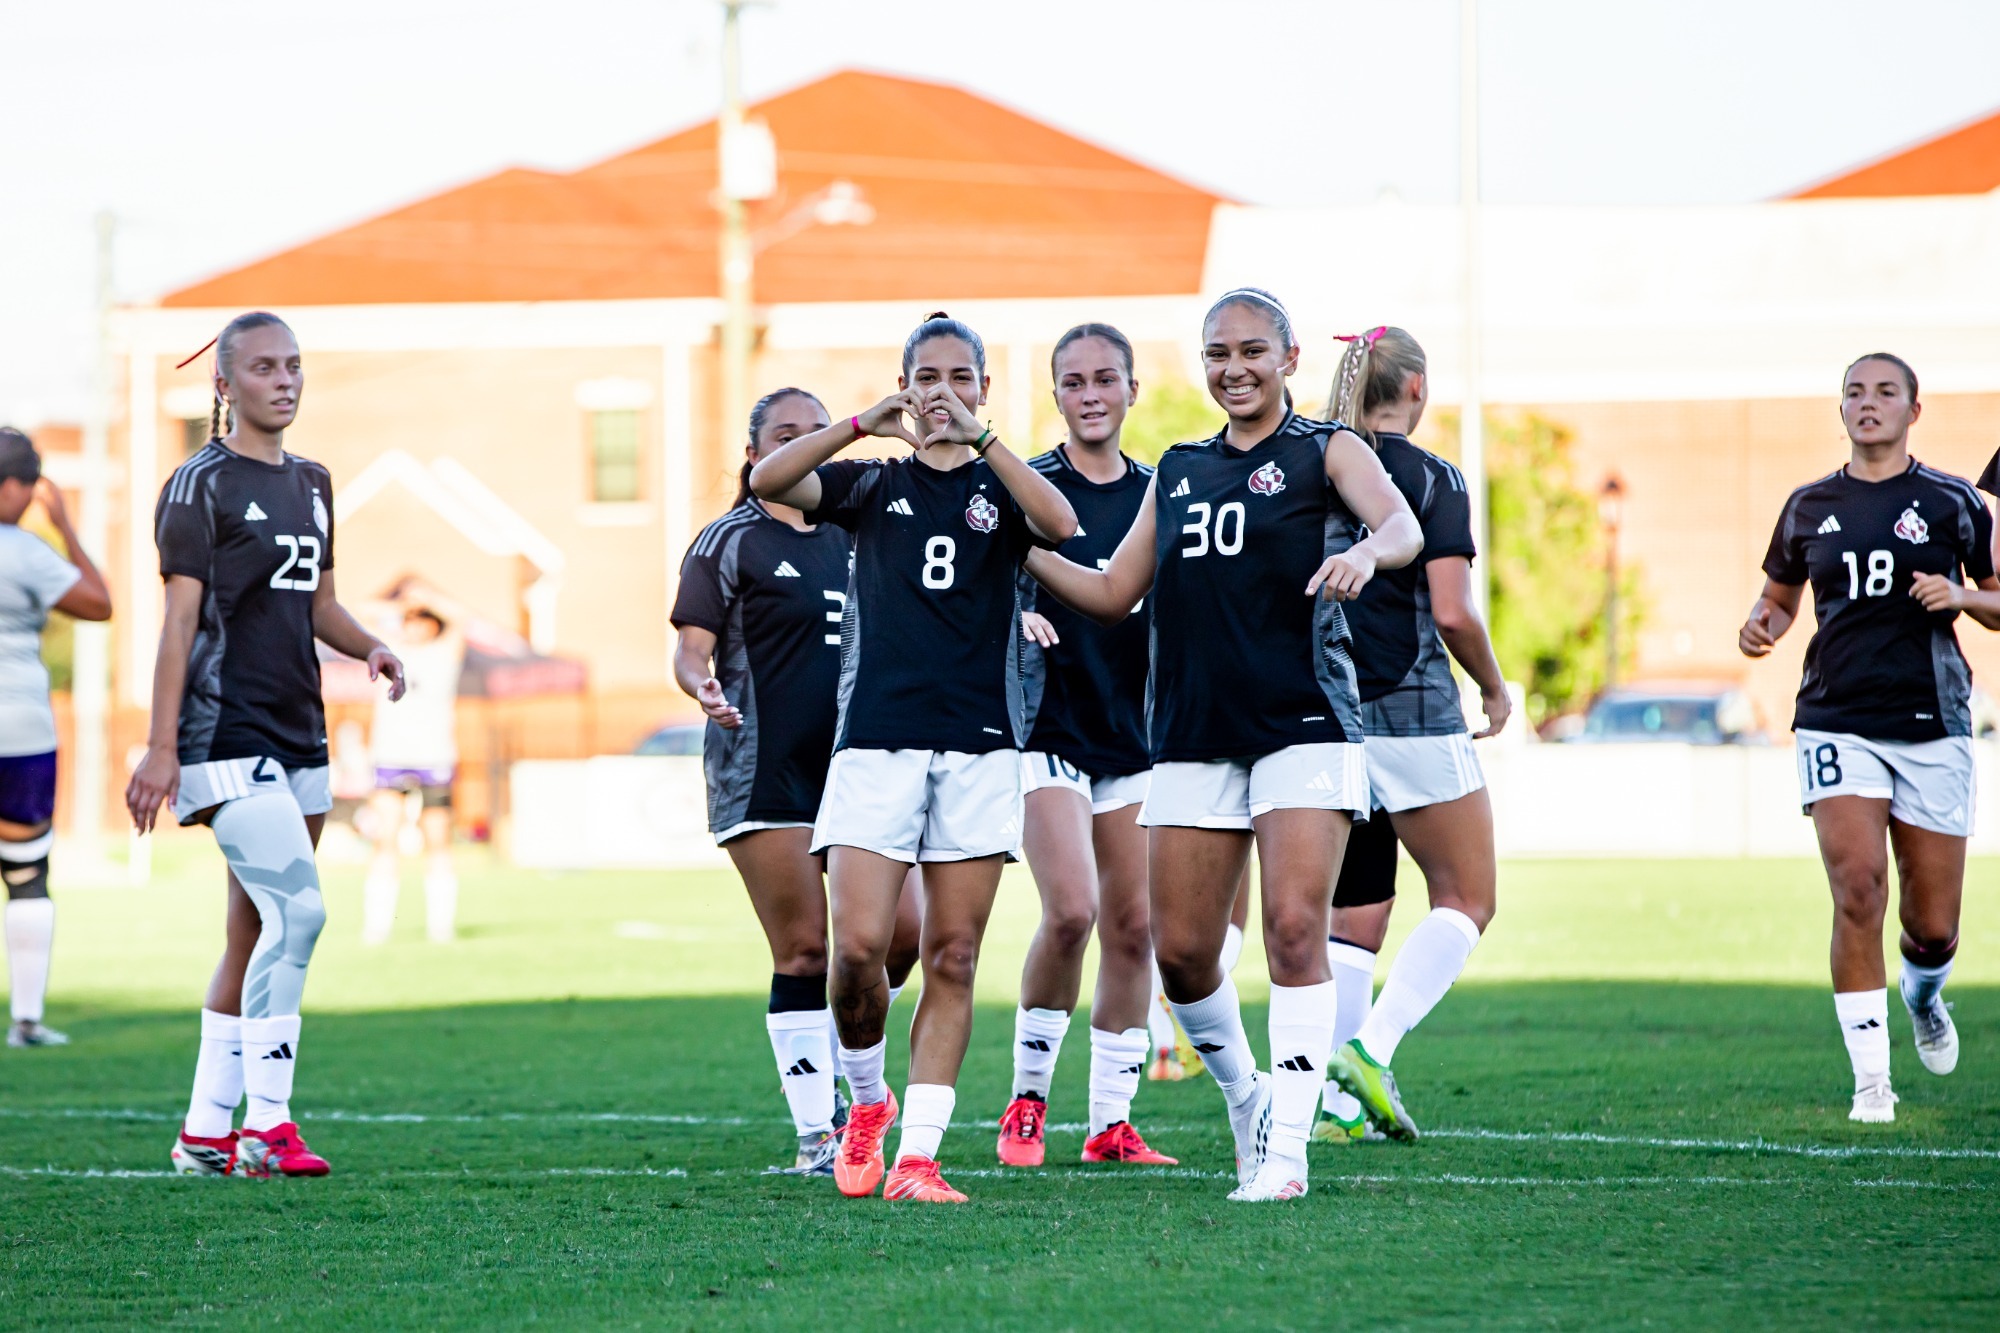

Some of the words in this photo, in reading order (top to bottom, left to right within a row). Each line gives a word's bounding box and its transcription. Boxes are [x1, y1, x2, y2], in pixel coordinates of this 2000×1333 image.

[1182, 502, 1246, 558] 30
[269, 534, 321, 591] 23
[922, 535, 956, 590] 8
[1842, 549, 1894, 600] 18
[1803, 742, 1843, 791] 18
